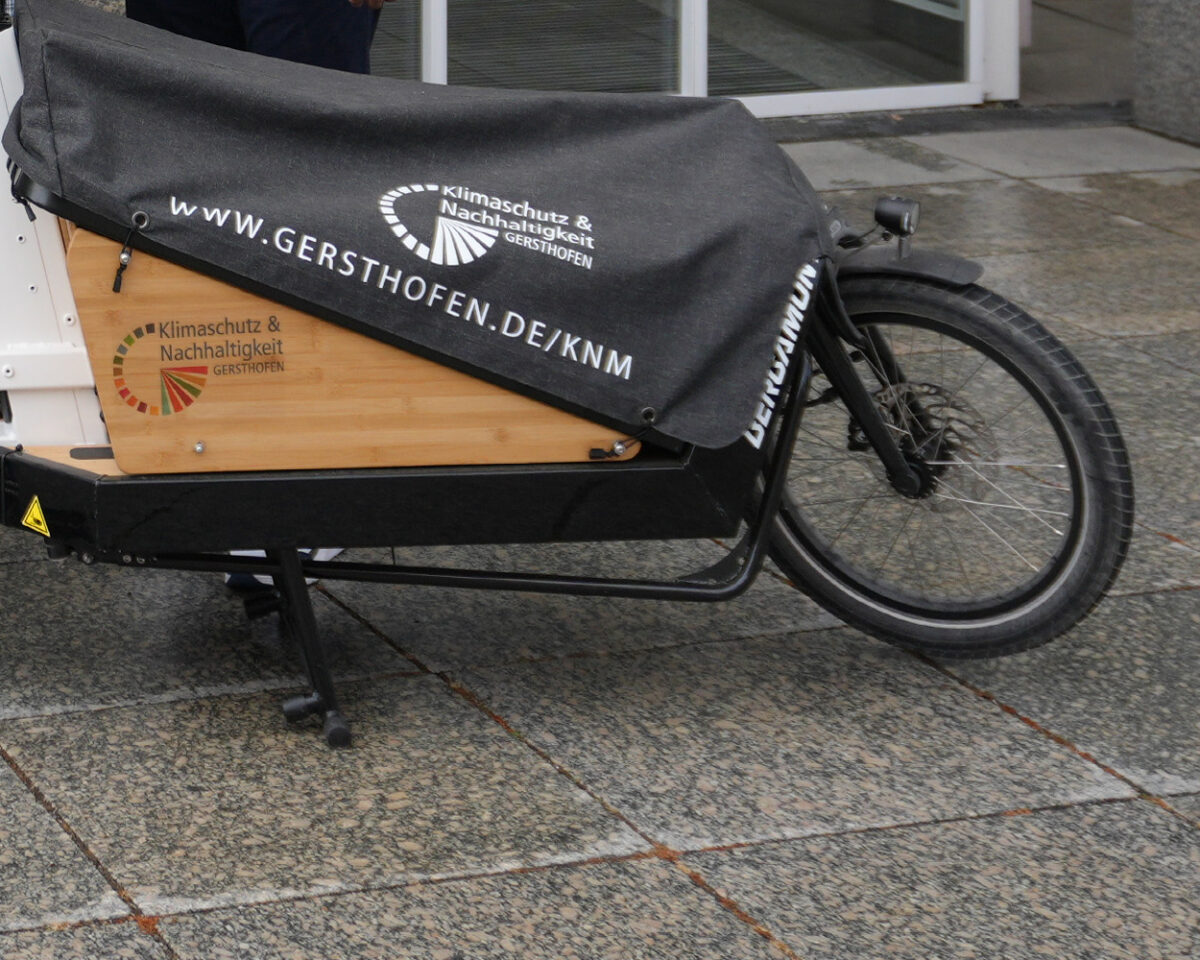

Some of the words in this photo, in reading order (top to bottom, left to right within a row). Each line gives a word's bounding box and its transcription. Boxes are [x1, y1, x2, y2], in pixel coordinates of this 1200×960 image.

[440, 199, 595, 249] Nachhaltigkeit
[442, 185, 569, 226] Klimaschutz
[575, 214, 592, 232] &
[504, 231, 593, 270] GERSTHOFEN
[159, 317, 261, 339] Klimaschutz
[267, 315, 281, 332] &
[160, 338, 283, 361] Nachhaltigkeit
[213, 361, 284, 376] GERSTHOFEN
